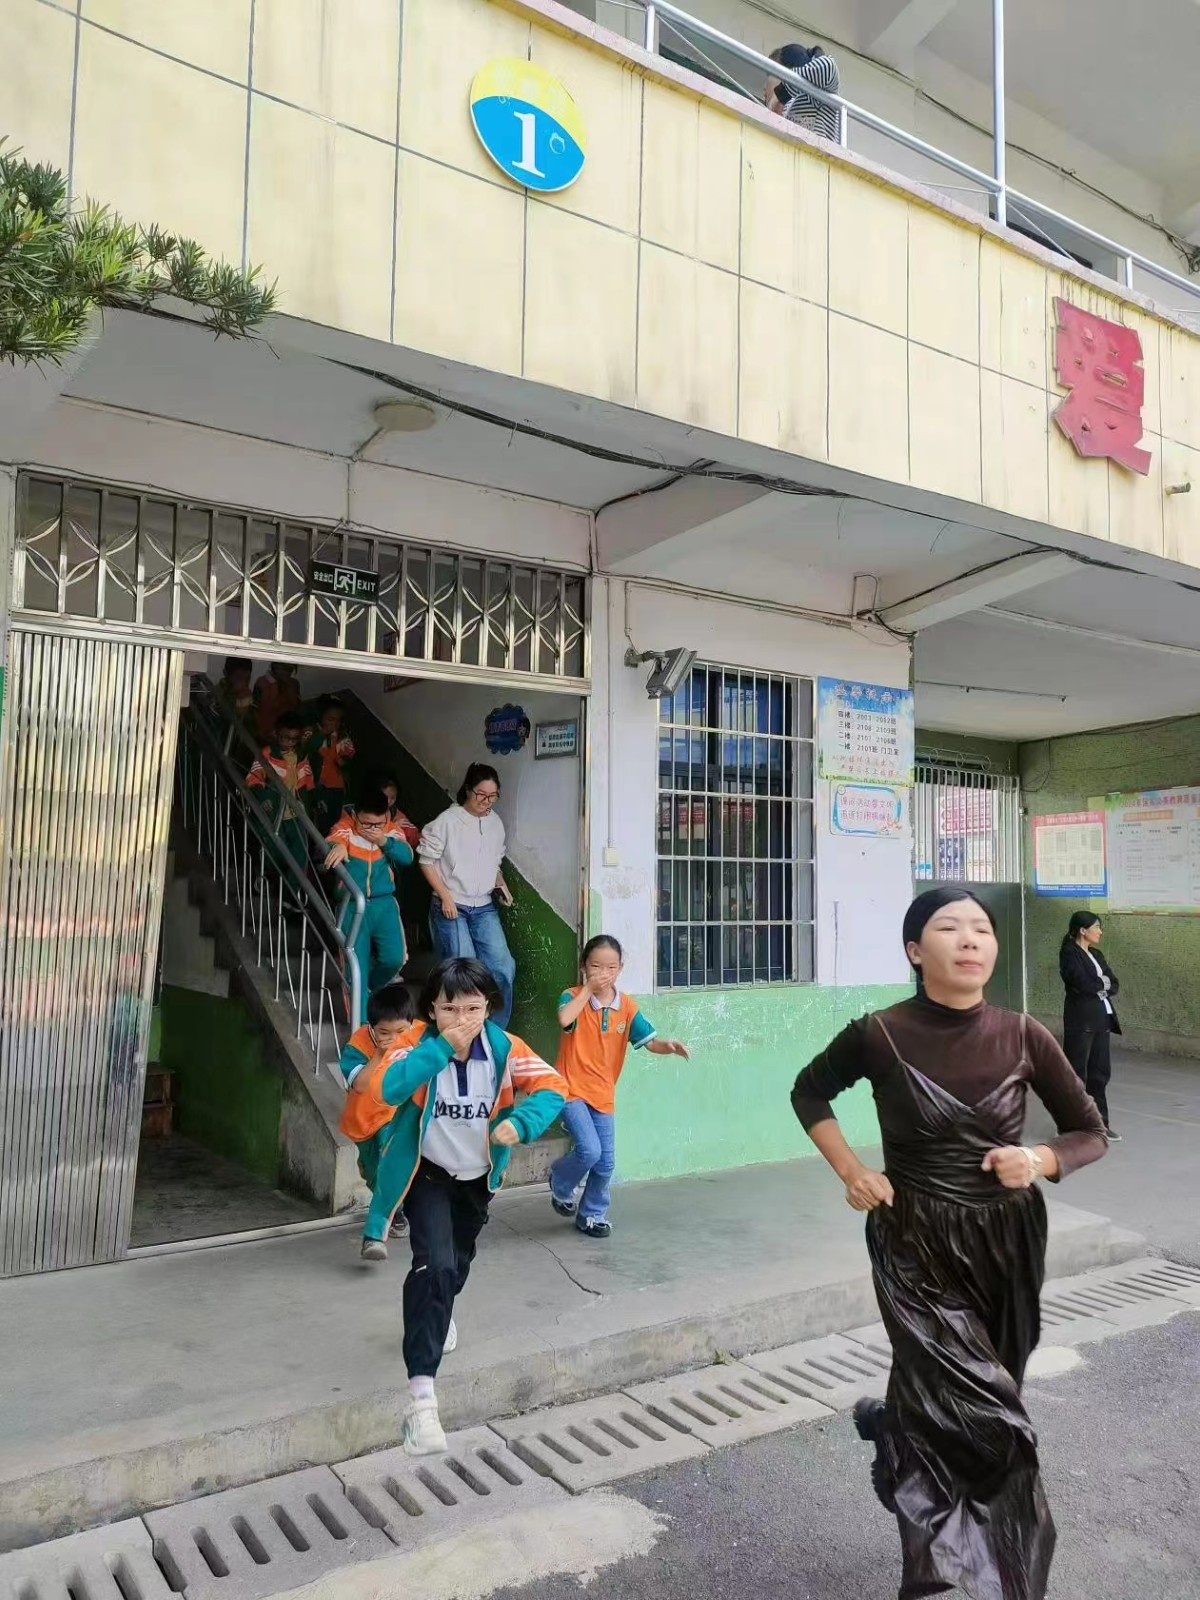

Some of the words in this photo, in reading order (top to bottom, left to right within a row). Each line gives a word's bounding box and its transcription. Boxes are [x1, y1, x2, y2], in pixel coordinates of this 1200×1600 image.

[511, 111, 546, 179] 1
[314, 571, 333, 583] 安全出口
[357, 579, 376, 592] EXIT
[431, 1100, 495, 1120] MBEA
